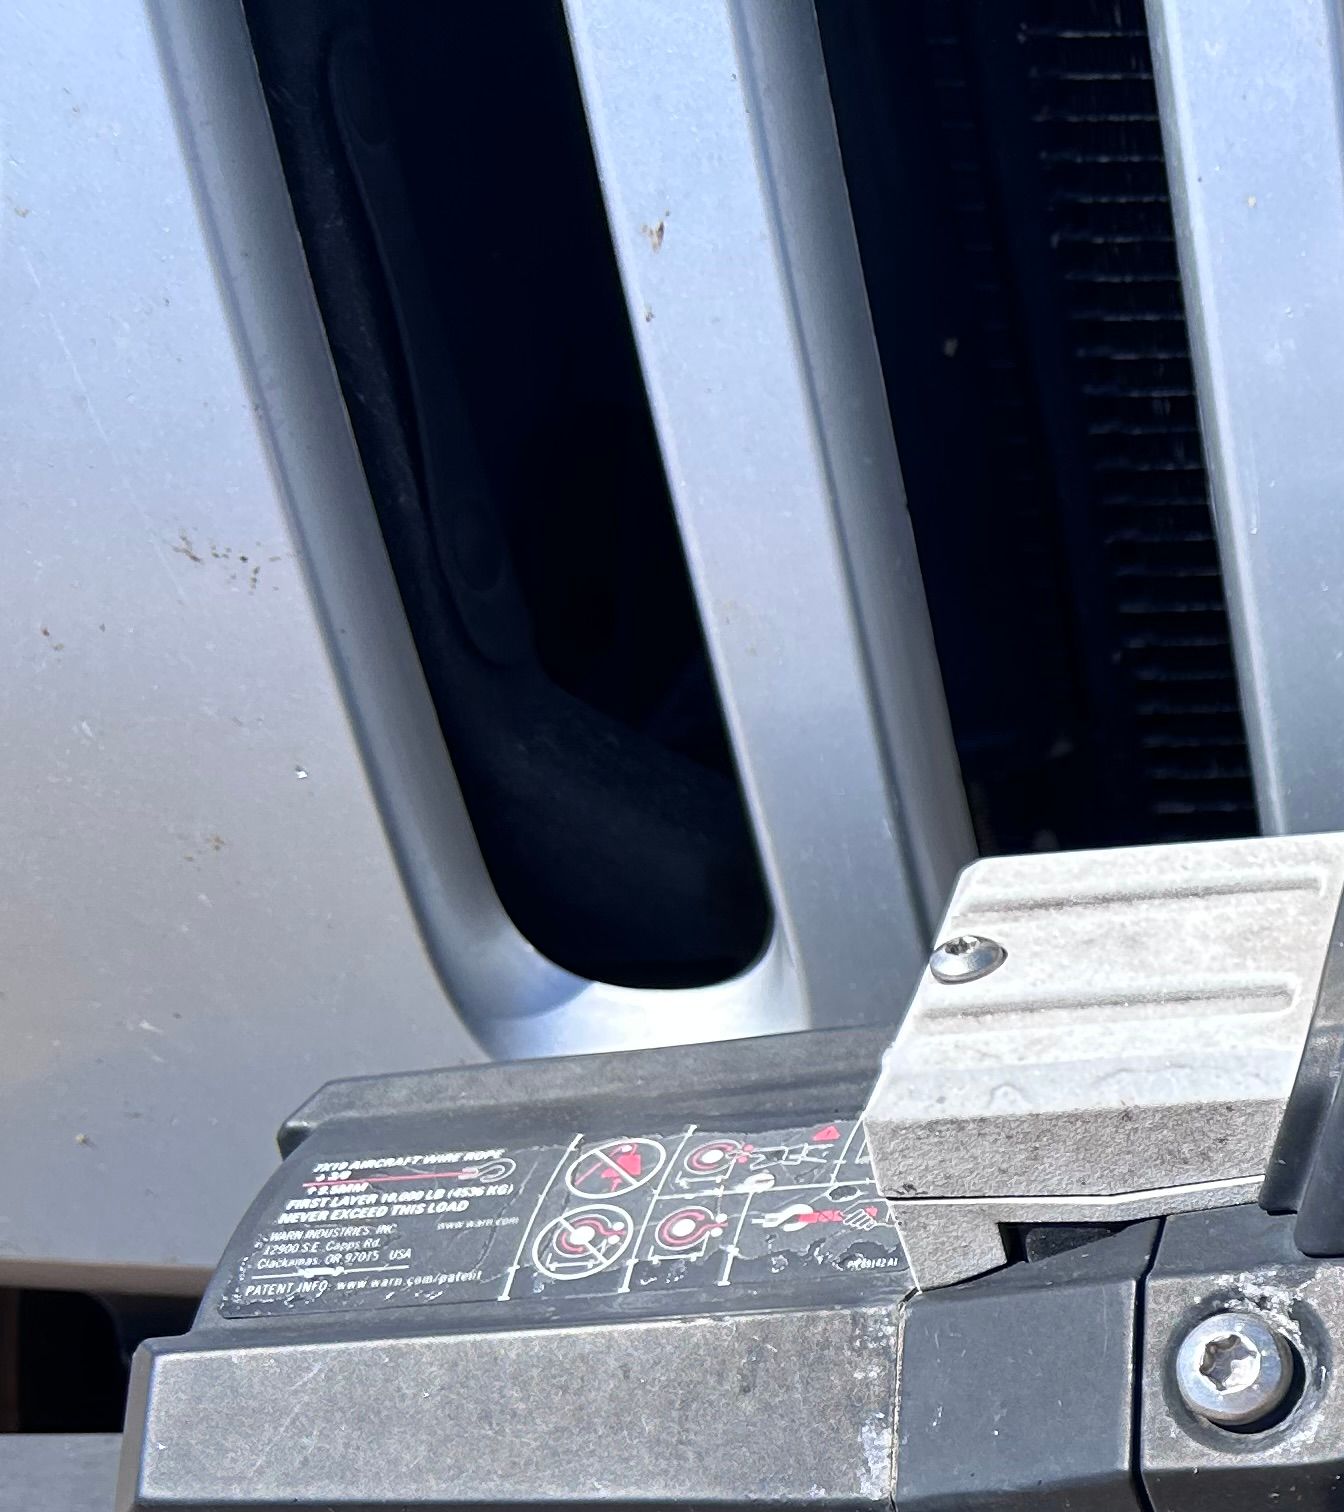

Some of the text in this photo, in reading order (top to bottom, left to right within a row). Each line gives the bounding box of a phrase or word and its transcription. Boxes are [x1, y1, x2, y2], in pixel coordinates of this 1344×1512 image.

[348, 1155, 423, 1170] AIRCRAFT
[463, 1149, 506, 1161] ROPE
[286, 1198, 328, 1211] FIRST
[330, 1194, 379, 1207] LAYER
[426, 1189, 446, 1200] LB
[277, 1200, 470, 1224] NEVER EXCEED THIS LOAD
[270, 1230, 300, 1242] WARN
[389, 1249, 412, 1260] USA
[246, 1283, 296, 1297] PATENT
